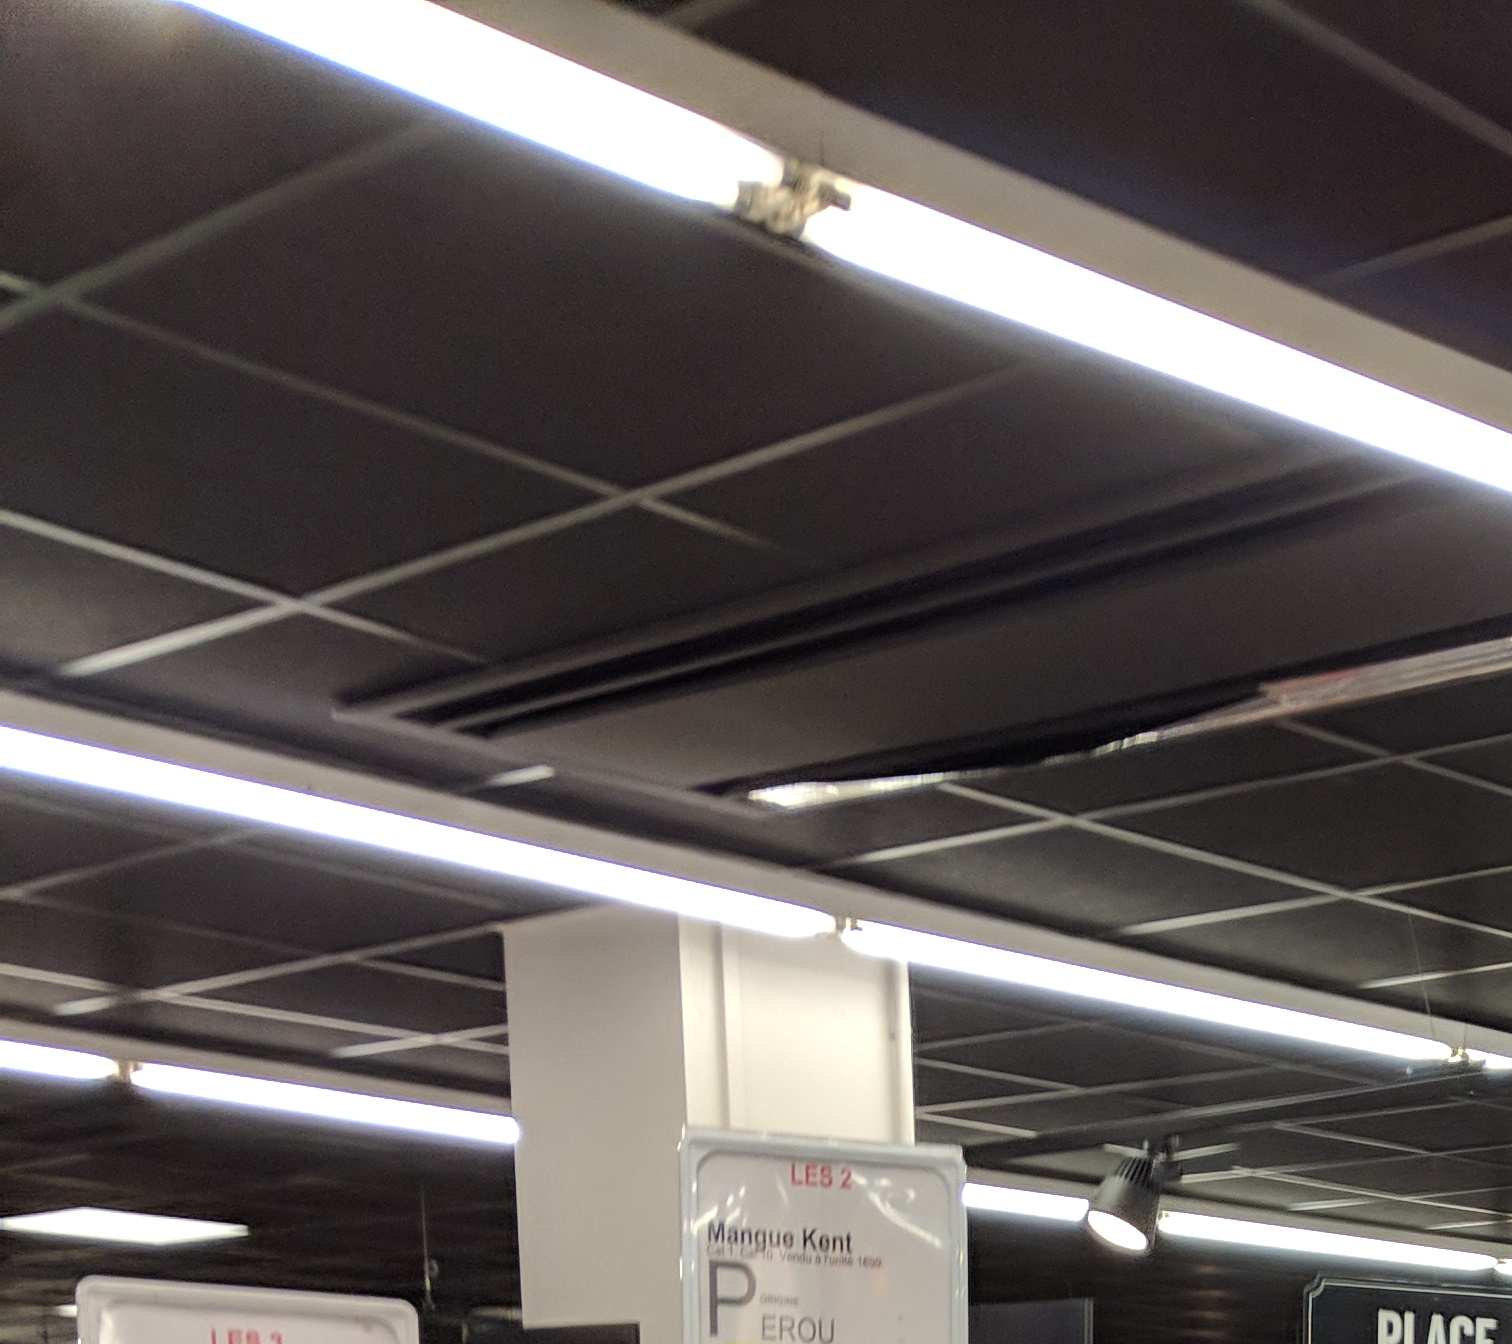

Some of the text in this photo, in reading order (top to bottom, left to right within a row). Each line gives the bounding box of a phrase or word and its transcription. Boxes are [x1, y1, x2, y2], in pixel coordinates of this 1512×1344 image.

[789, 1162, 853, 1190] LES 2
[707, 1222, 853, 1255] Mangue Kent
